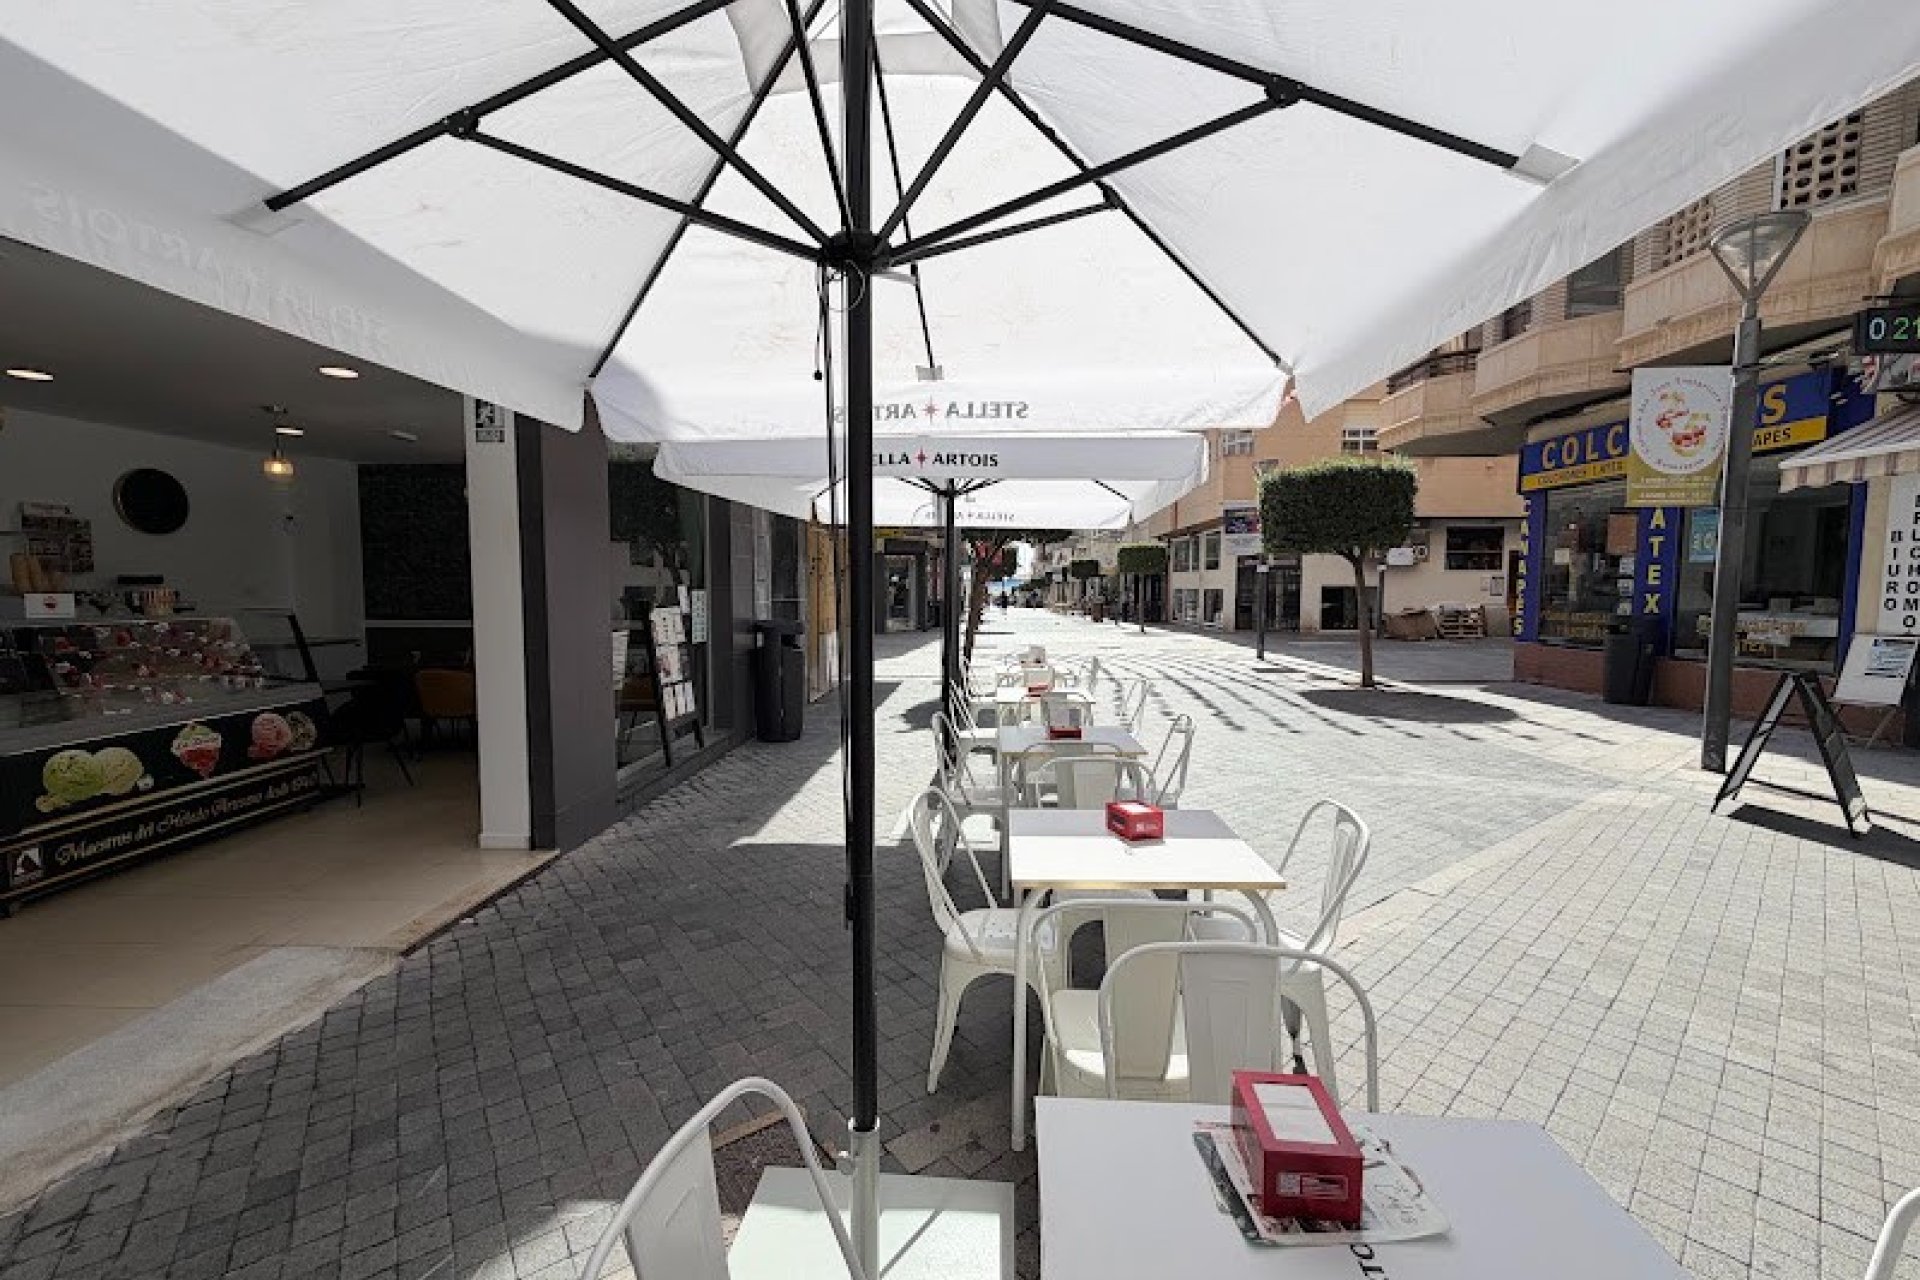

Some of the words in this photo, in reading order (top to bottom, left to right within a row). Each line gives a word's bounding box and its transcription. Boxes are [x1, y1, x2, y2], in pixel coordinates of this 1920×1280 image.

[932, 453, 999, 467] ARTOIS
[1643, 508, 1668, 614] ATEX
[1884, 531, 1903, 611] BIURO
